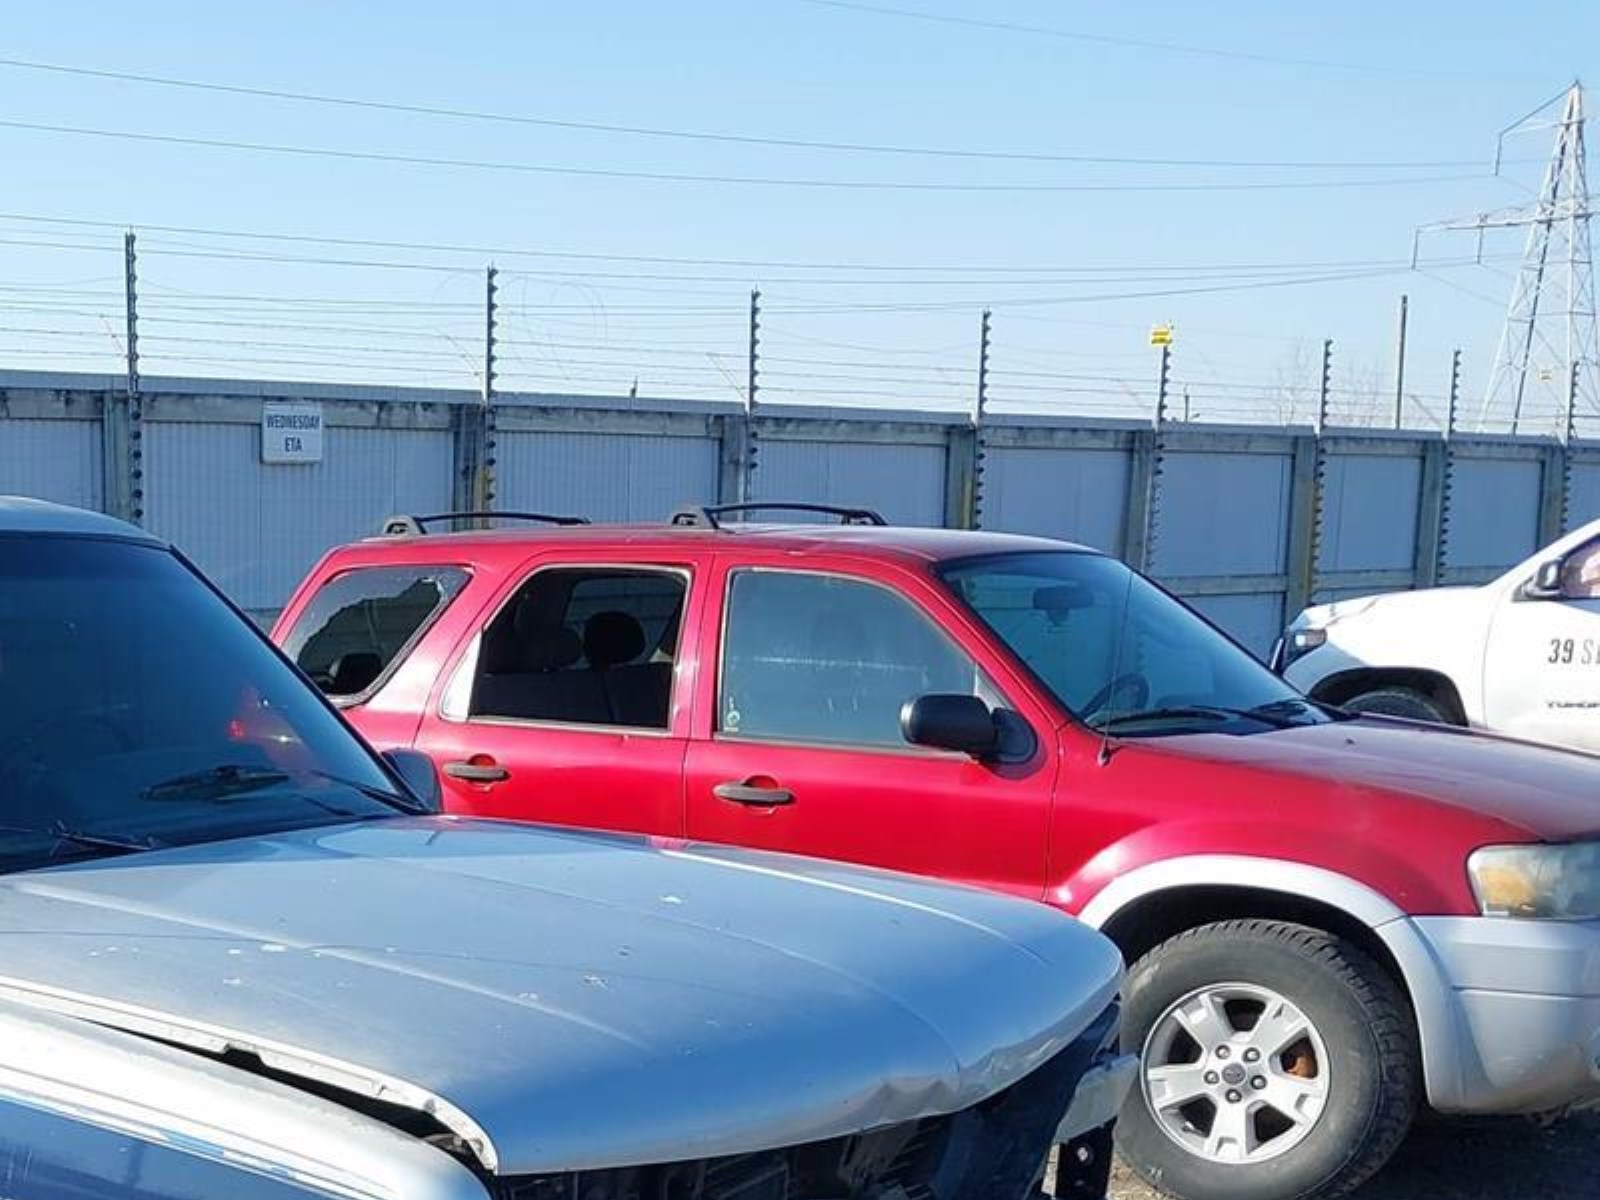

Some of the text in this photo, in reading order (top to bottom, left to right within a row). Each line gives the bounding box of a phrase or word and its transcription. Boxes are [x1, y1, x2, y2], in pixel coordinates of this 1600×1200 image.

[266, 414, 320, 429] WEDNESDAY
[285, 437, 302, 452] ETA
[1548, 638, 1574, 664] 39
